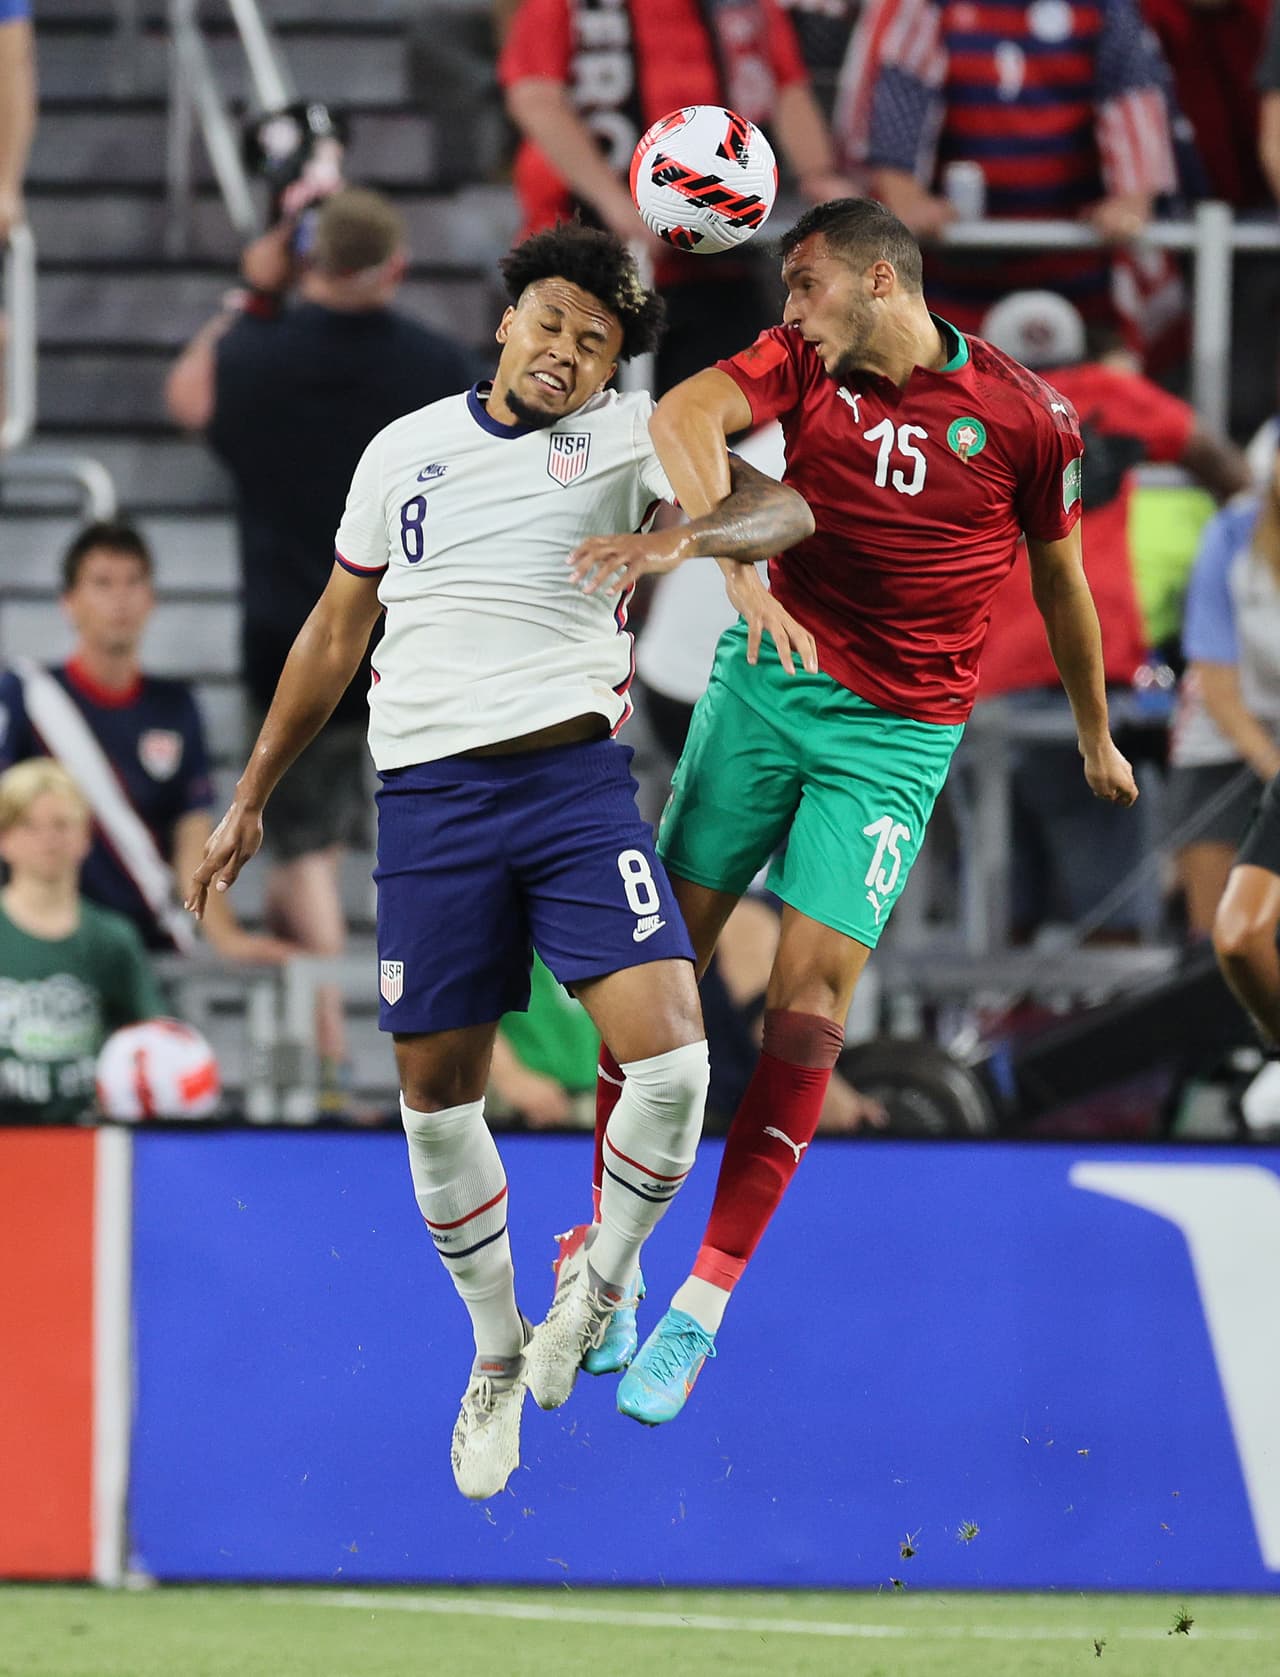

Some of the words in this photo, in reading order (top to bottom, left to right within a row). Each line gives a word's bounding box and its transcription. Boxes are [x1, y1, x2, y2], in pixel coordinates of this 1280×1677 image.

[554, 436, 586, 455] USA
[863, 418, 928, 496] 15
[424, 463, 448, 476] NIKE
[400, 495, 427, 564] 8
[863, 815, 911, 896] 15
[618, 849, 660, 915] 8
[637, 914, 660, 933] NIKE
[383, 962, 401, 980] USA
